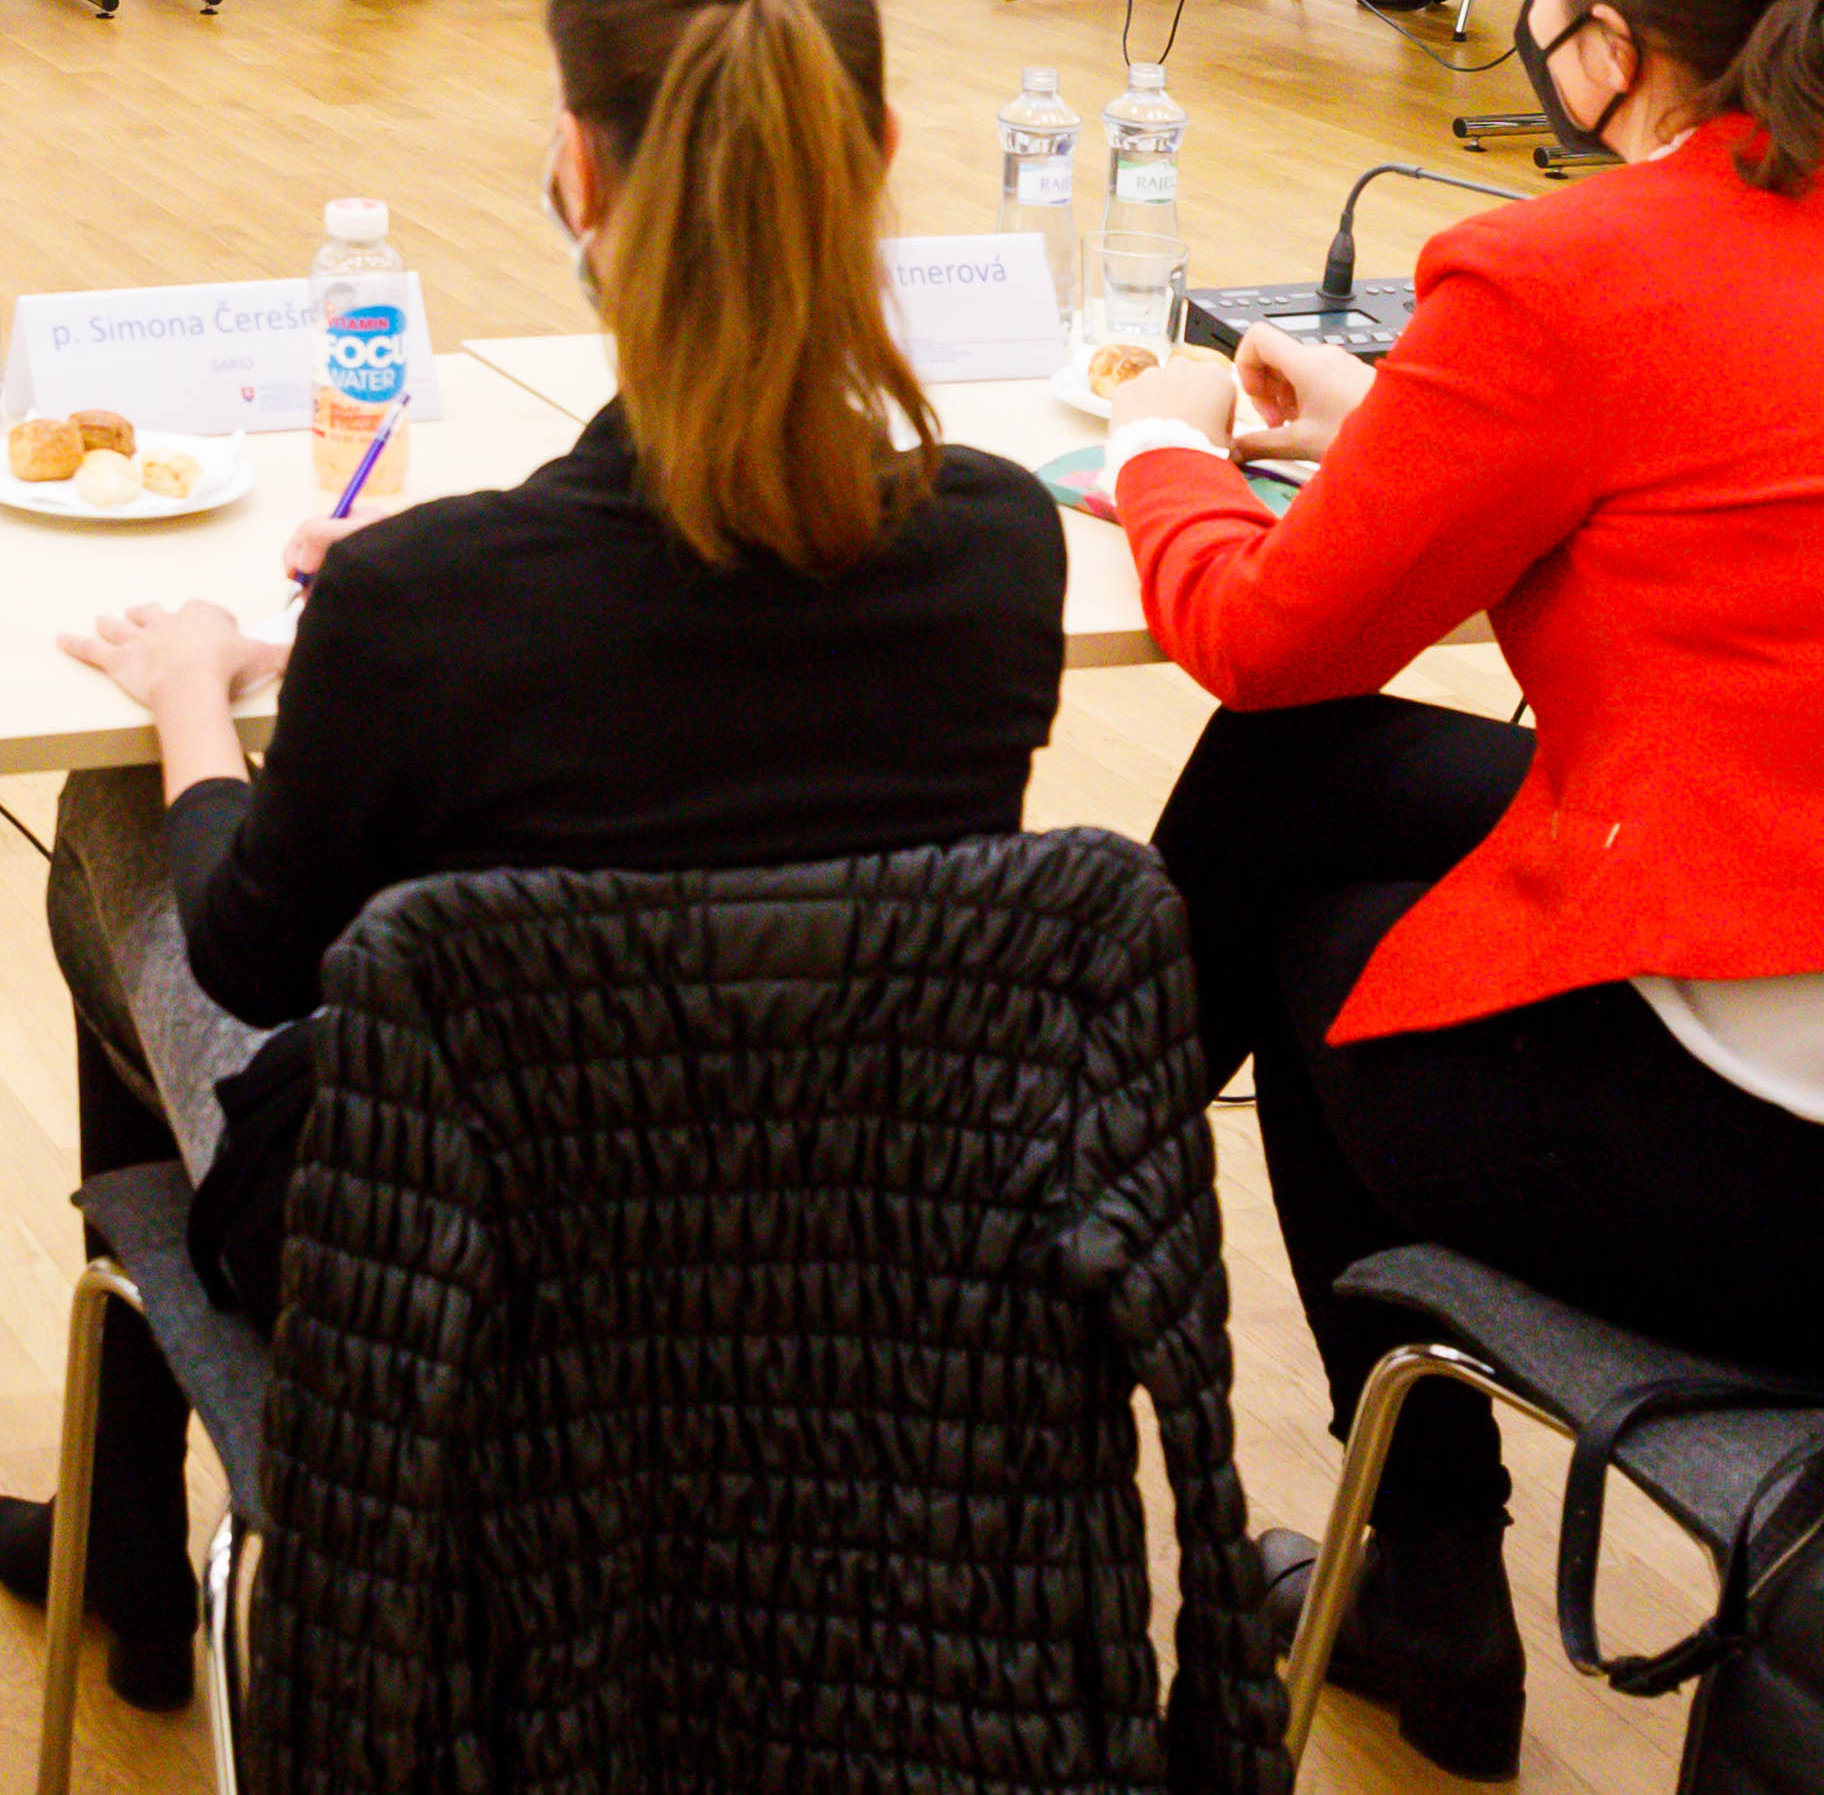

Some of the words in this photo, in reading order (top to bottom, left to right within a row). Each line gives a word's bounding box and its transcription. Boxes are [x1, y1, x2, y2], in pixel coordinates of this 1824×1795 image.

[895, 254, 1007, 286] tnerová
[52, 322, 81, 351] p.
[89, 315, 205, 343] Simona
[214, 301, 317, 334] Čerešn
[327, 316, 390, 331] VITAMIN
[330, 367, 396, 392] WATER
